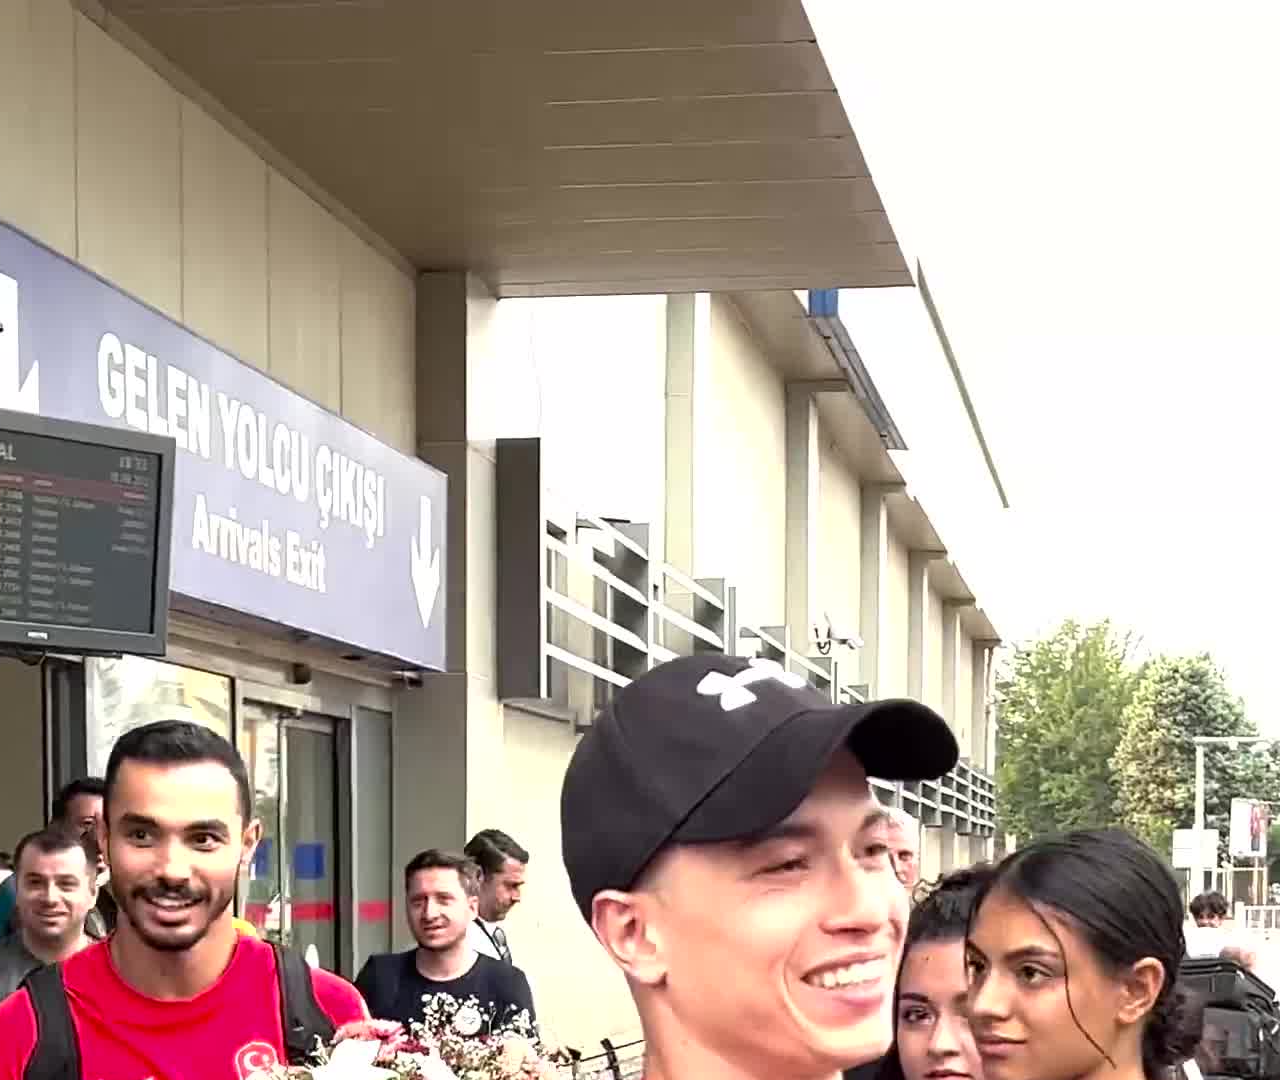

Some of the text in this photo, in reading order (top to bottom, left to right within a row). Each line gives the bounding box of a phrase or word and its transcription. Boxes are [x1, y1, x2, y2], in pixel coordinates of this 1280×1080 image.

[97, 332, 385, 549] GELEN YOLCU ÇIKIŞI
[192, 494, 281, 576] Arrivals
[286, 530, 326, 593] Exit
